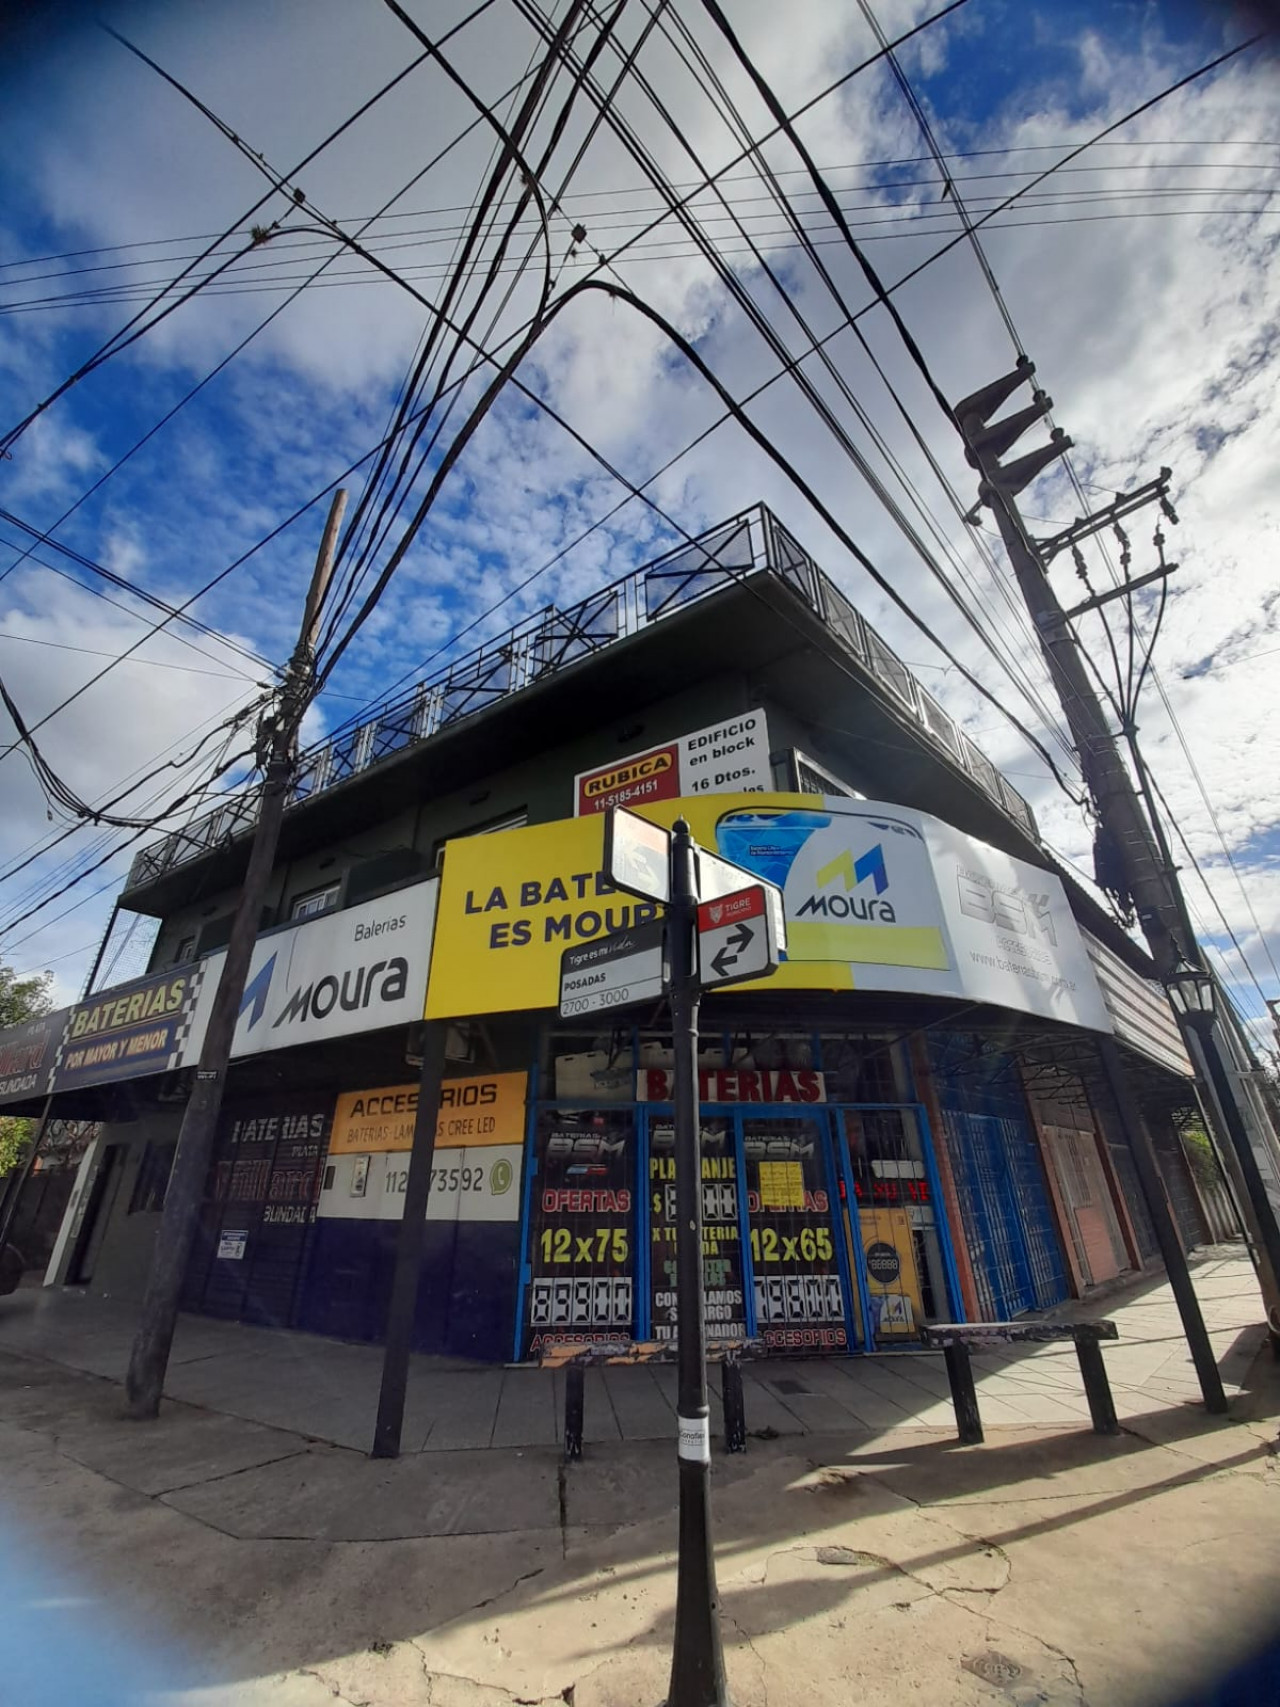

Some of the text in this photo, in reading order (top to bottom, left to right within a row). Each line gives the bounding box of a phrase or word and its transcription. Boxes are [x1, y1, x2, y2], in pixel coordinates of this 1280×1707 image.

[588, 719, 756, 793] RUBICA EDIFICIO
[689, 737, 755, 766] en block
[594, 766, 755, 810] 11-5185-4151 16 Dtos.
[465, 870, 615, 915] LA BATE
[725, 897, 751, 912] TIGRE
[489, 903, 658, 949] ES MOUR
[569, 952, 588, 966] Tigre
[589, 950, 598, 960] es
[564, 973, 606, 992] POSADAS
[72, 978, 186, 1038] BATERIAS
[563, 998, 589, 1016] 2700
[599, 988, 629, 1008] 3000
[65, 1053, 83, 1070] POR
[85, 1042, 116, 1067] MAYOR
[118, 1042, 126, 1058] Y
[127, 1029, 168, 1057] MENOR
[350, 1083, 497, 1118] ACCESRIOS
[647, 1070, 820, 1102] BTERIAS
[448, 1118, 474, 1137] CREE
[478, 1116, 495, 1134] LED
[653, 1130, 726, 1148] BM
[385, 1167, 484, 1194] 11273592
[542, 1189, 631, 1213] OFERTAS
[541, 1228, 628, 1264] 12x75
[751, 1228, 832, 1262] 12x65
[655, 1290, 743, 1308] CONLAMOS
[763, 1328, 847, 1347] CCESORIOS
